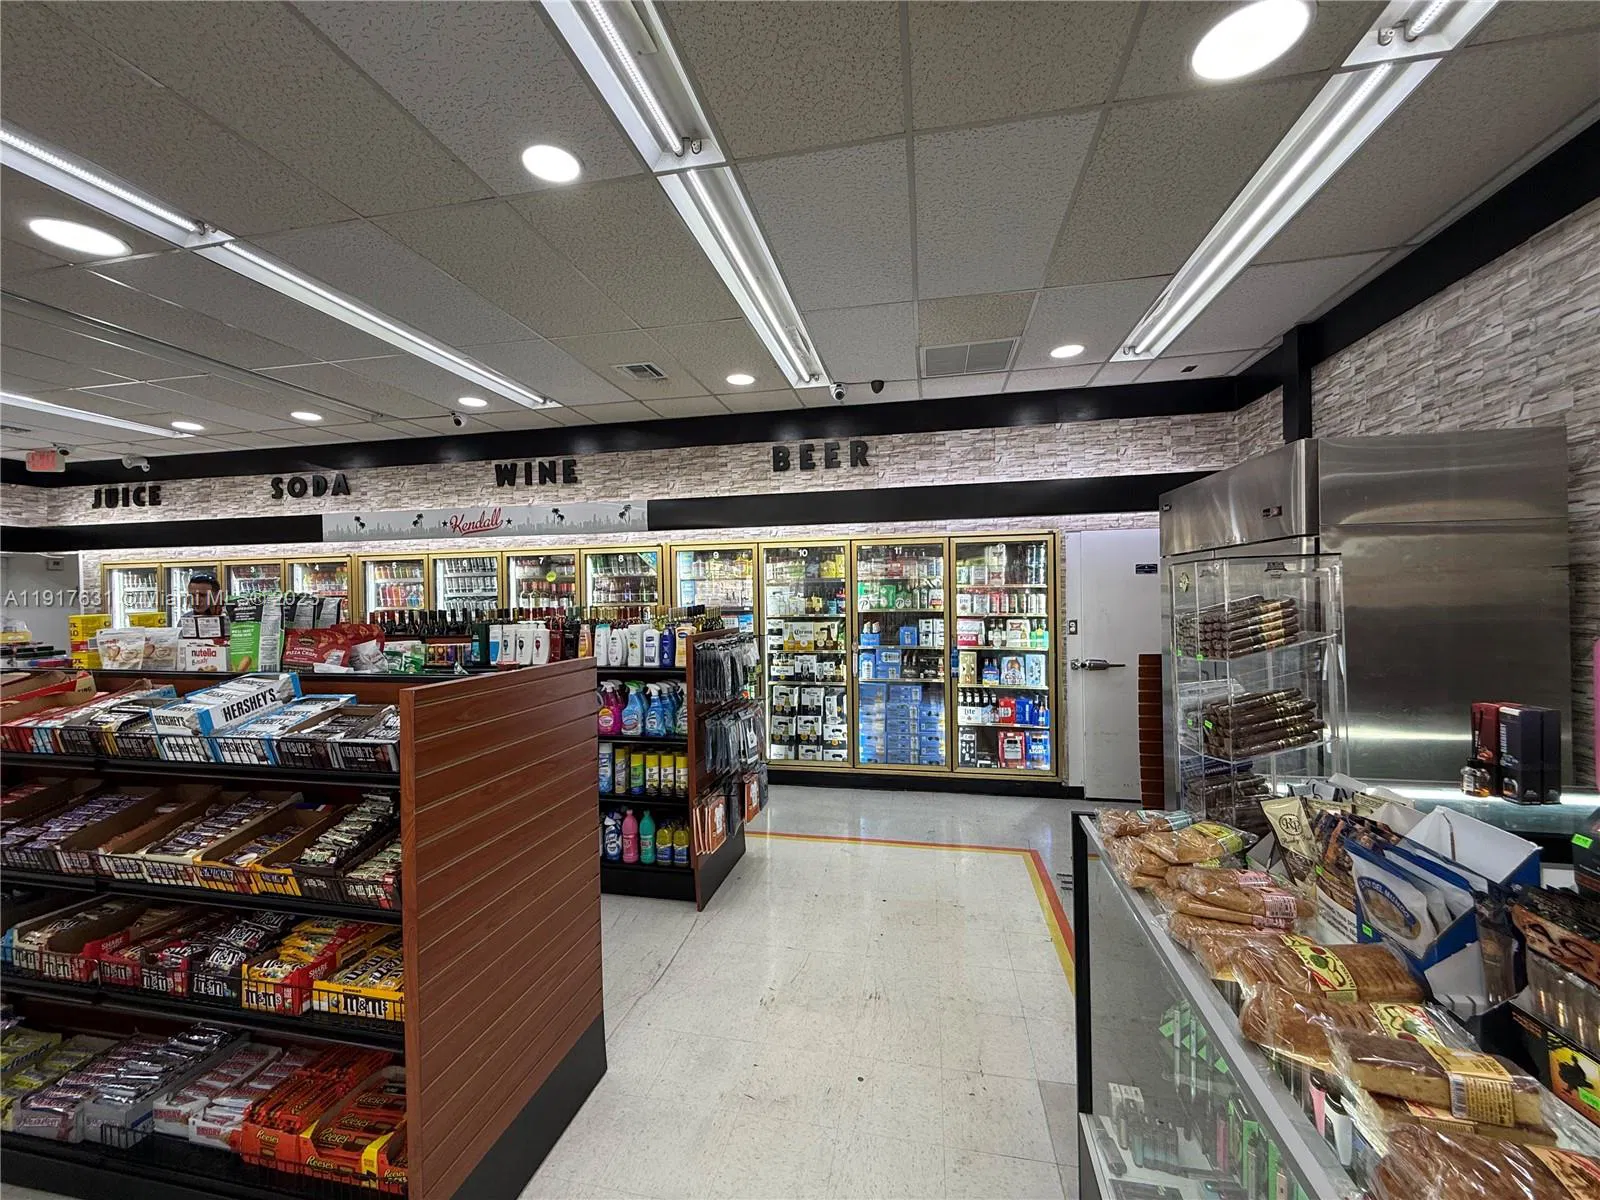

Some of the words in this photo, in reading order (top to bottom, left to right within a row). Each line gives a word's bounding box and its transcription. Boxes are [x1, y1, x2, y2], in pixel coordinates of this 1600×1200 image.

[772, 440, 869, 472] BEER
[495, 459, 579, 487] WINE
[92, 485, 162, 509] JUICE
[271, 474, 350, 499] SODA
[449, 507, 503, 536] Kendall
[799, 549, 808, 557] 10
[191, 647, 217, 657] nutella
[222, 687, 277, 723] HERSHEY'S
[154, 714, 187, 726] HERSHEY'S
